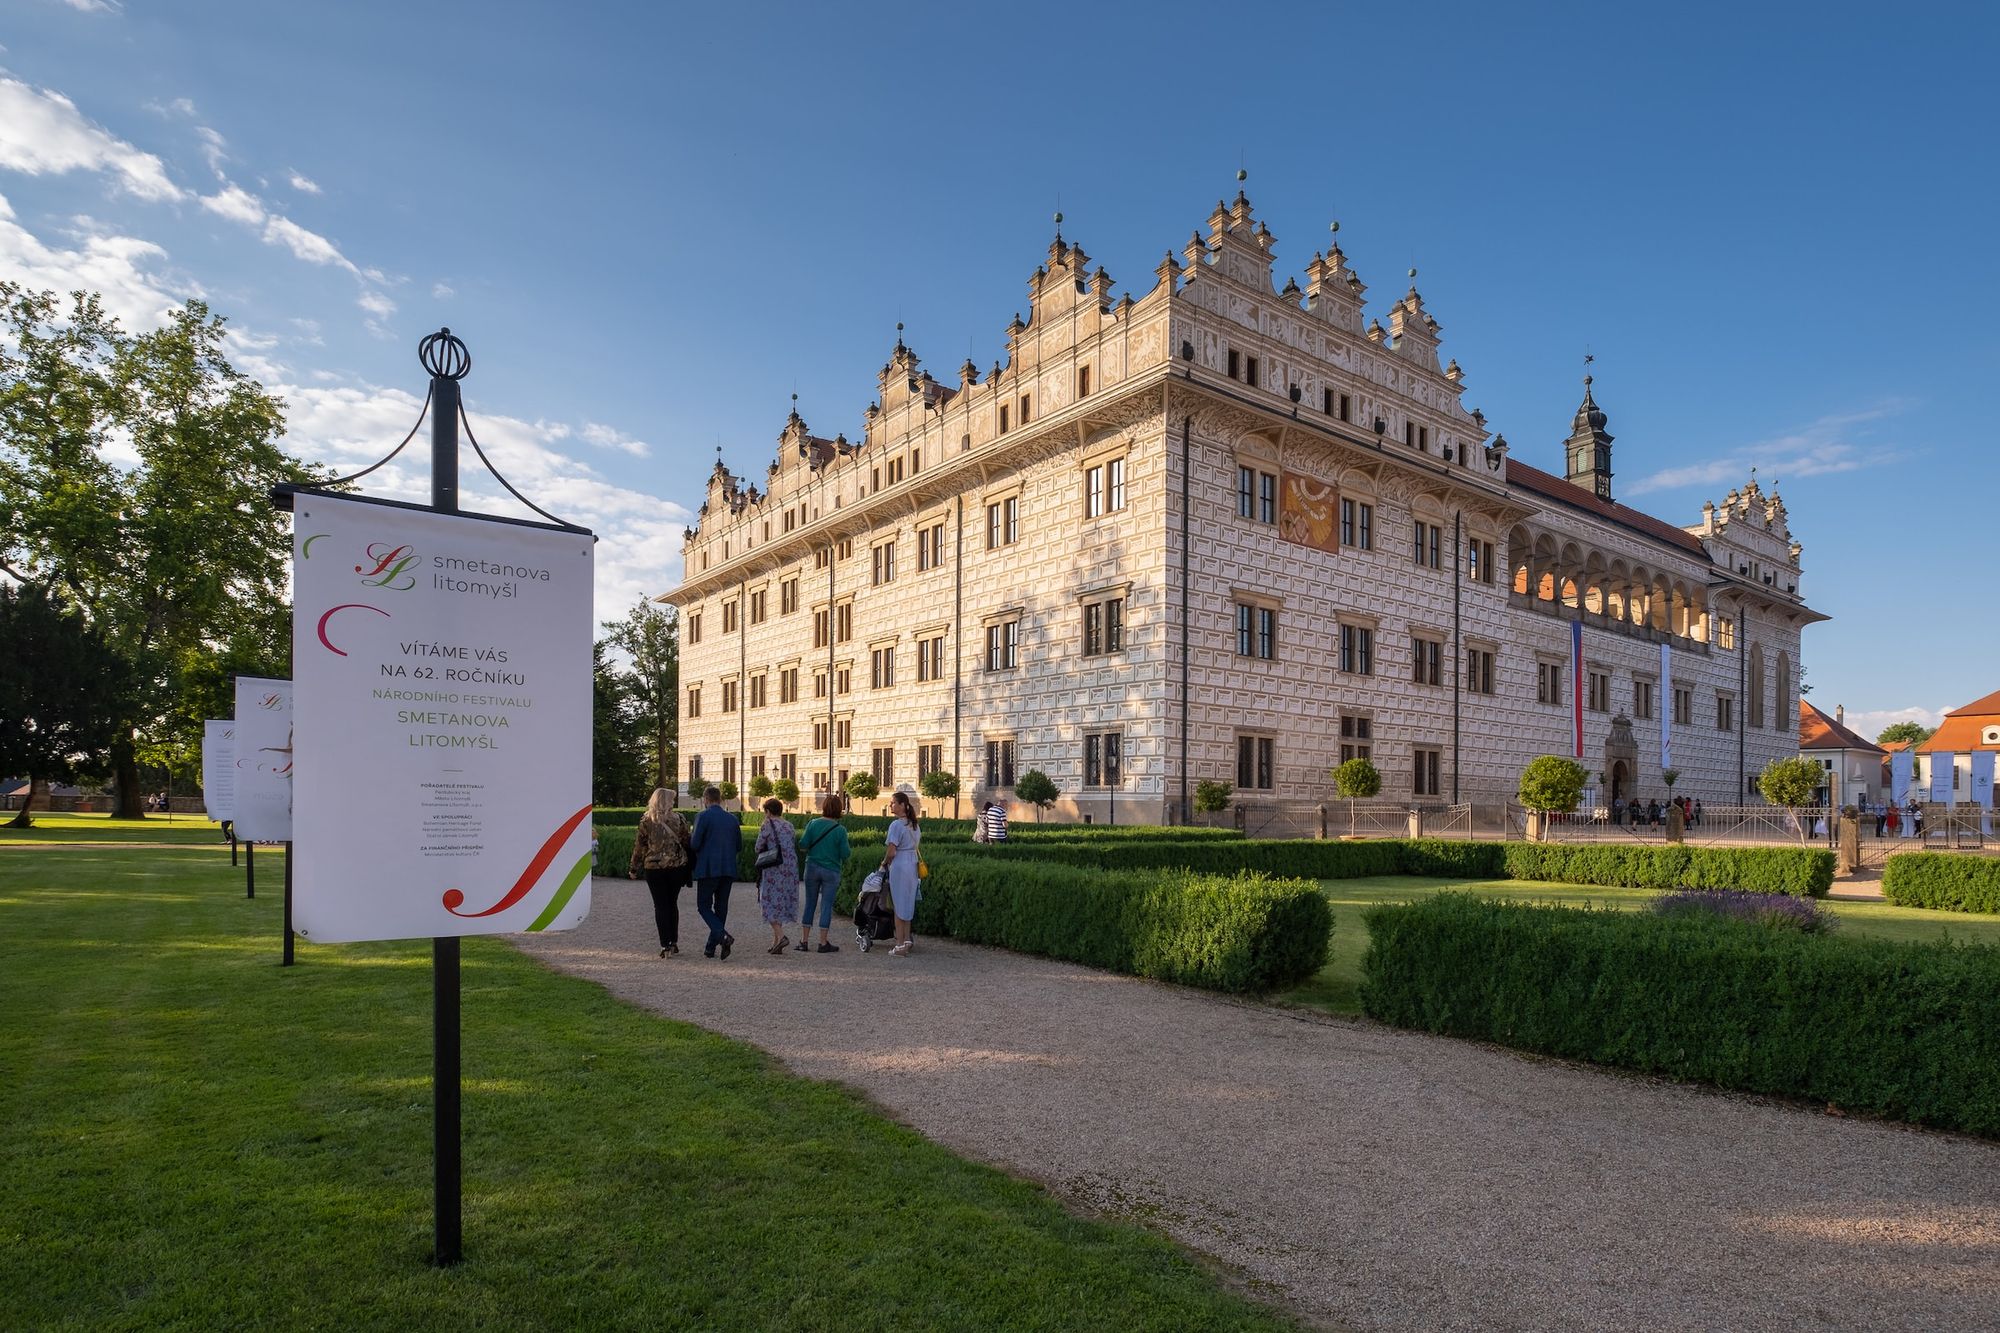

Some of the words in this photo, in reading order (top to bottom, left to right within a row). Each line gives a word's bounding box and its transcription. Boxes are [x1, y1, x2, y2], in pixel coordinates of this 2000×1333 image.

[433, 555, 550, 581] smetanova
[433, 573, 517, 599] litomyšl
[400, 640, 469, 660] VÍTÁME
[474, 647, 508, 663] VÁS
[381, 664, 407, 678] NA
[413, 667, 439, 680] 62.
[446, 668, 525, 686] ROČNÍKU
[372, 687, 459, 704] NÁRODNÍHO
[463, 694, 532, 708] FESTIVALU
[398, 711, 509, 729] SMETANOVA
[409, 734, 499, 749] LITOMYŠL
